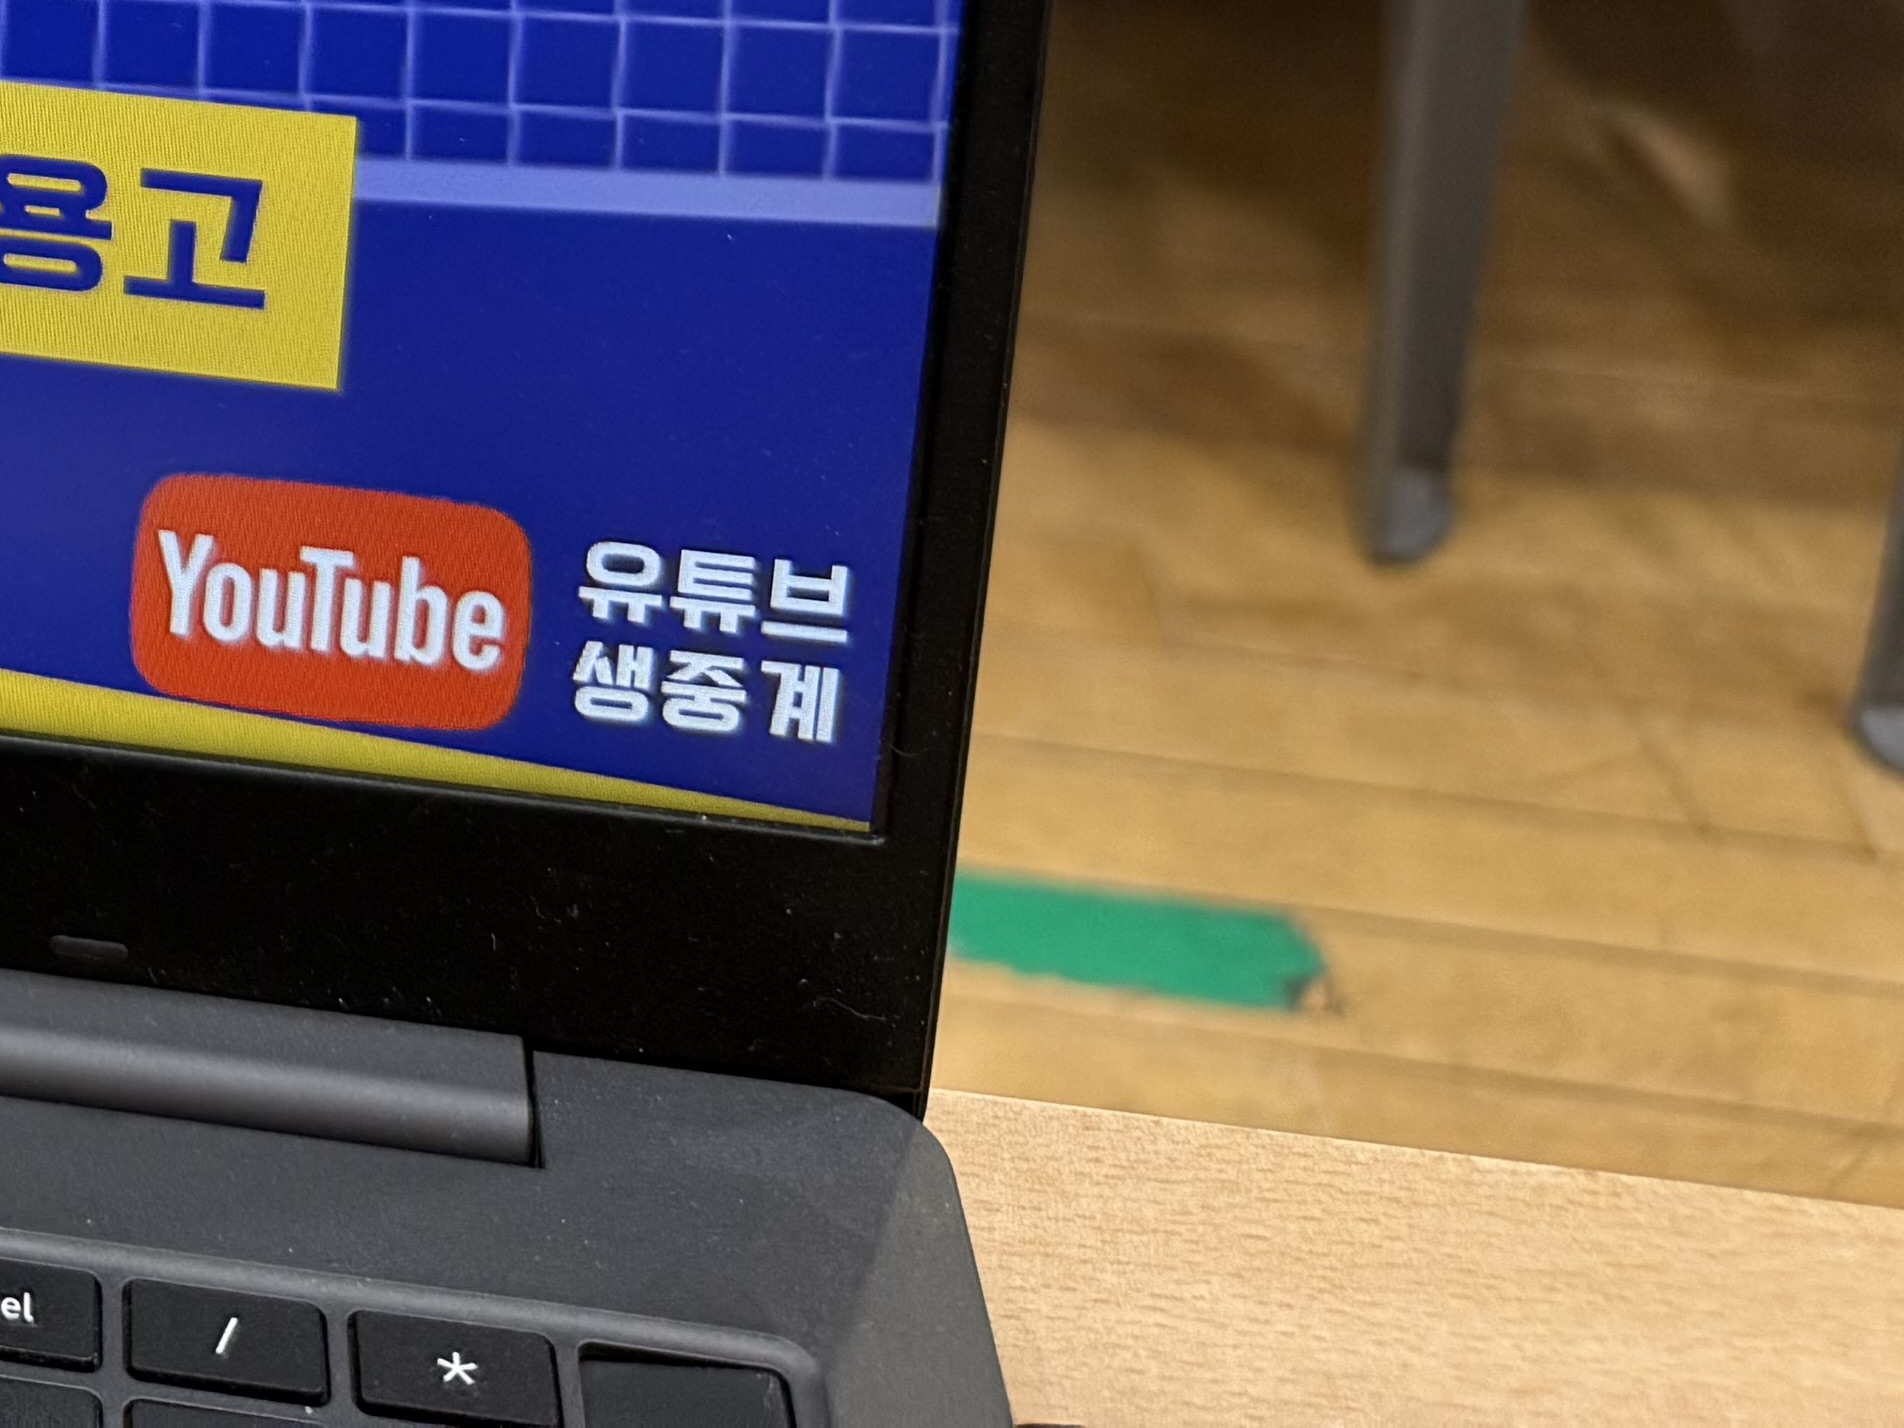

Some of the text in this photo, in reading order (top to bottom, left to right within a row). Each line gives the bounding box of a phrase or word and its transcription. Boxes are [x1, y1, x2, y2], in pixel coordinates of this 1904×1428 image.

[159, 530, 504, 671] YouTube
[579, 540, 849, 643] 유튜브
[573, 639, 841, 743] 생중계
[216, 1318, 237, 1354] /
